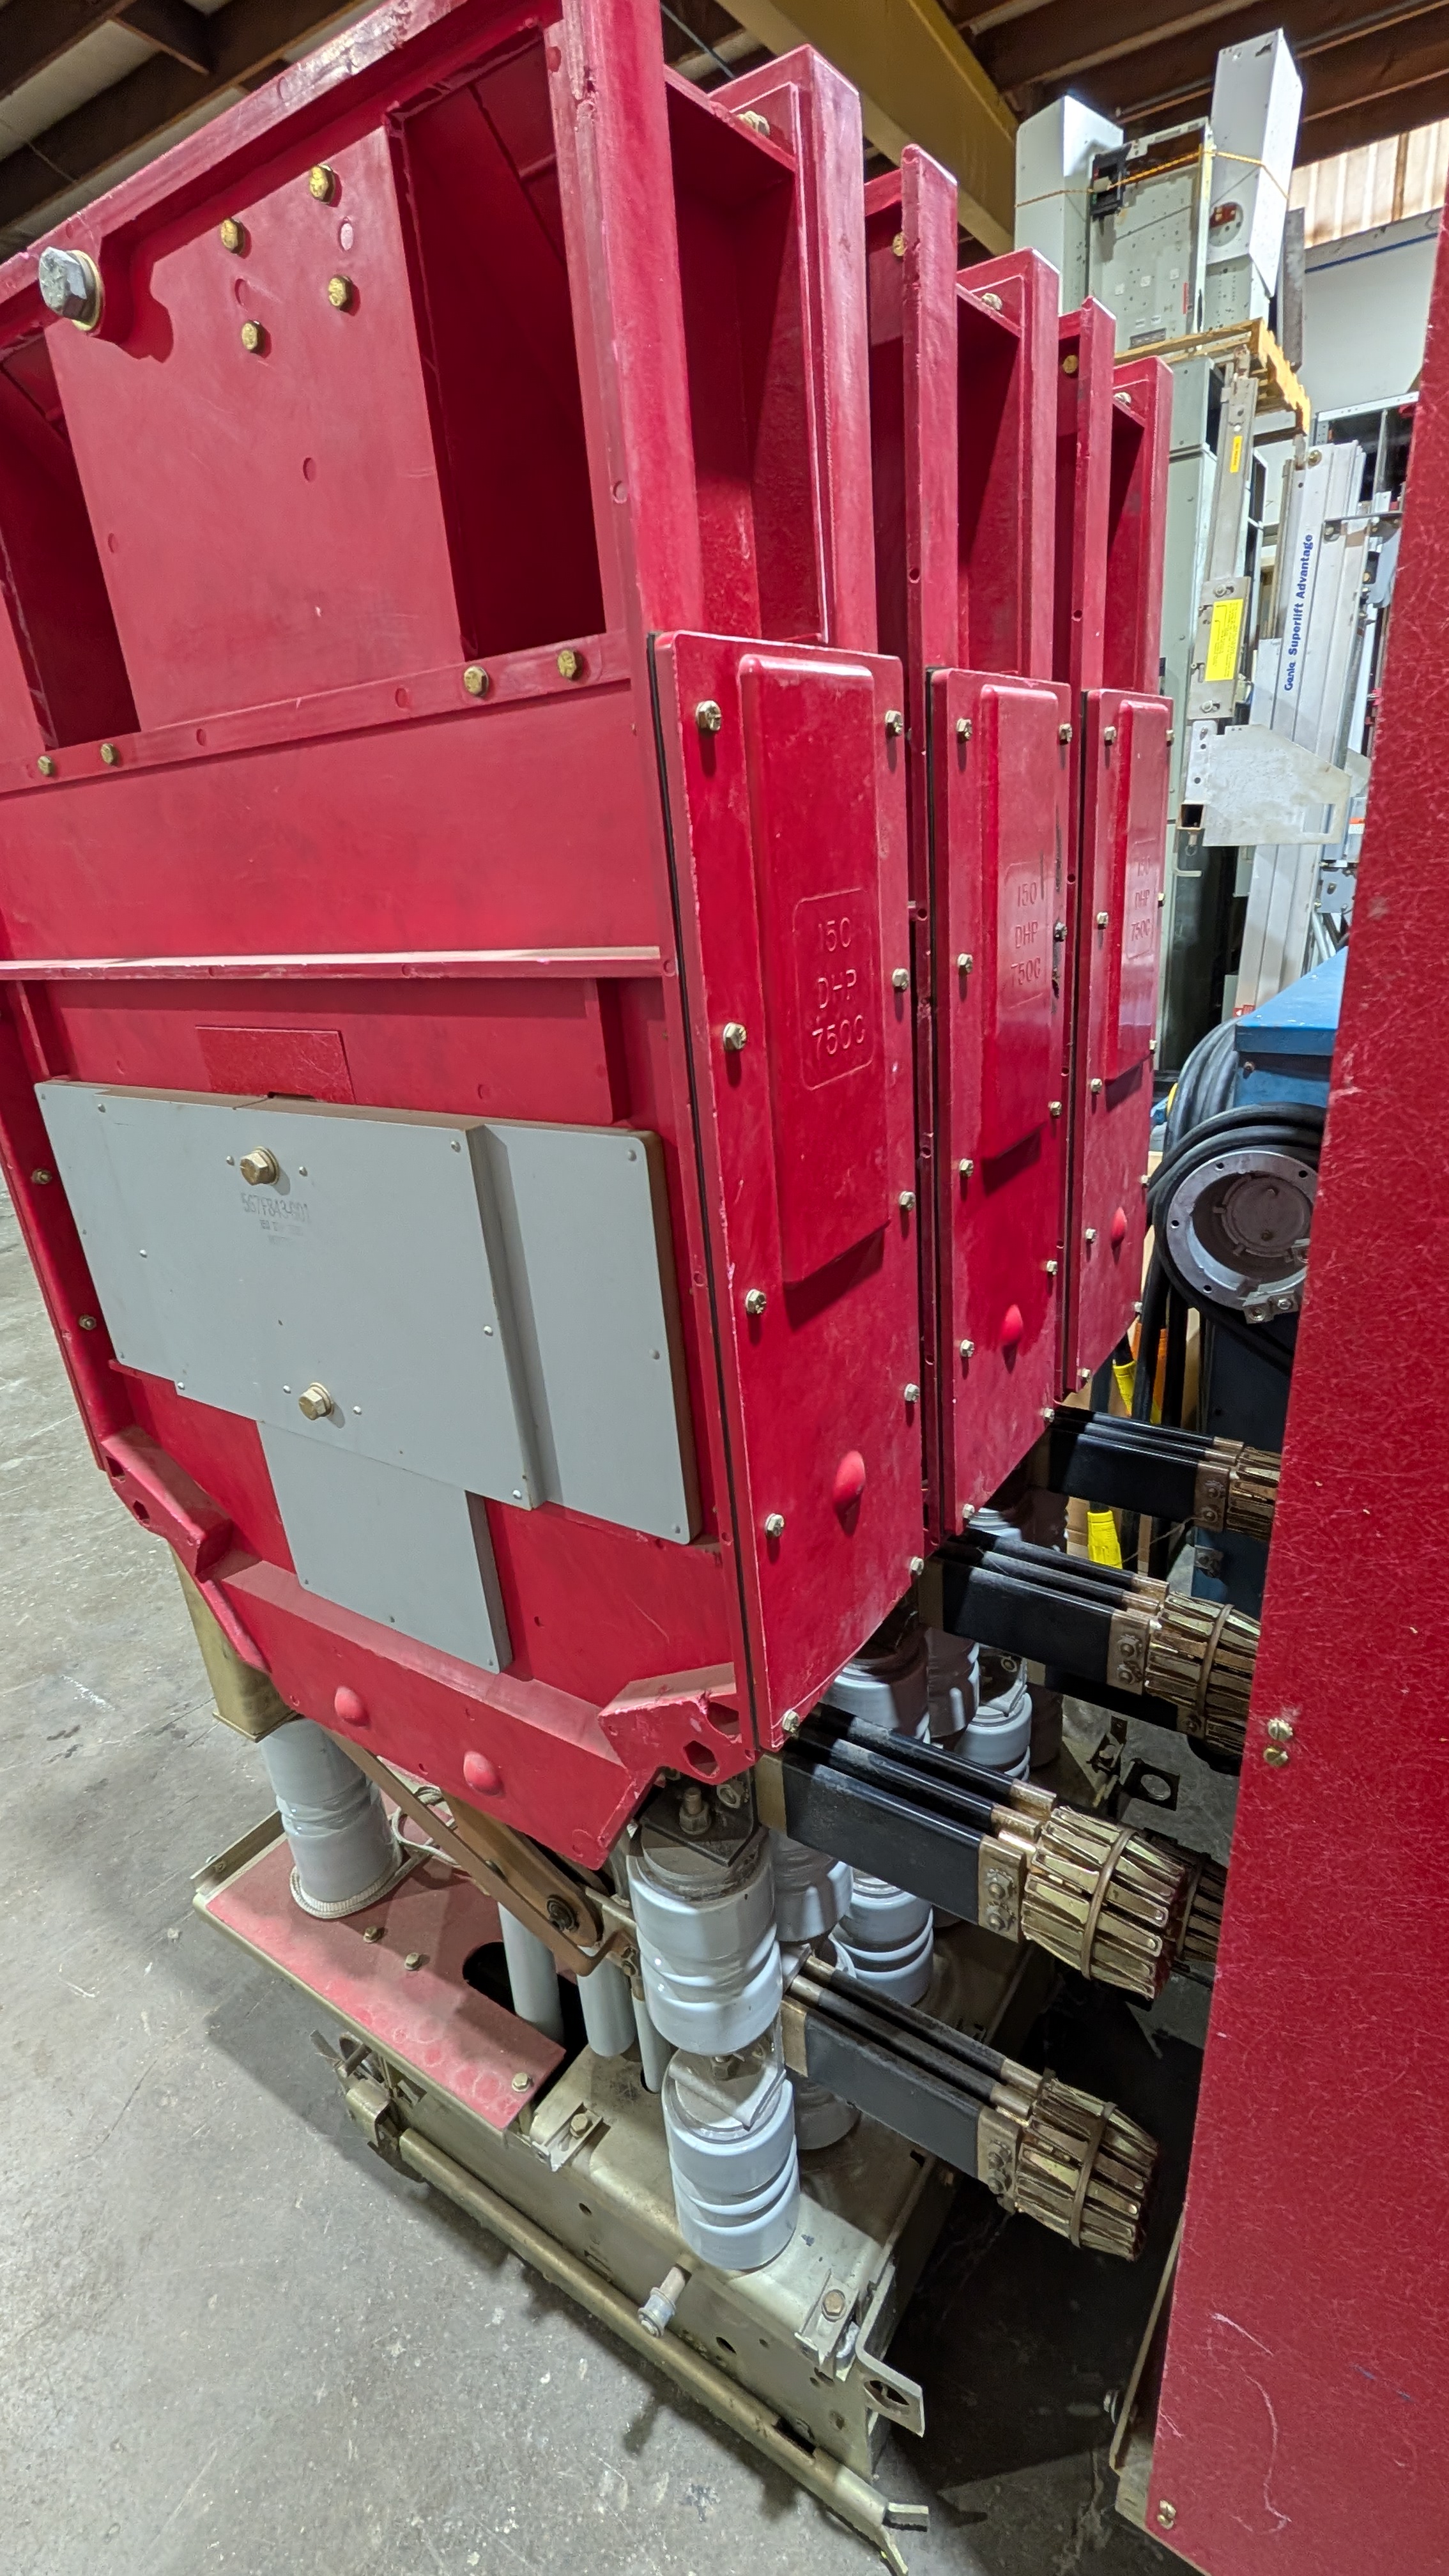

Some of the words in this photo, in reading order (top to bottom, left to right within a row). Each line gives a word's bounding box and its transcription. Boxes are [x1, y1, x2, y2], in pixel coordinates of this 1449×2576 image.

[1288, 602, 1304, 656] Superlift
[1296, 533, 1314, 599] Advantage
[1017, 882, 1038, 907] 150
[818, 917, 852, 952] 150
[1015, 921, 1039, 949] DHP
[818, 969, 857, 1009] DHP
